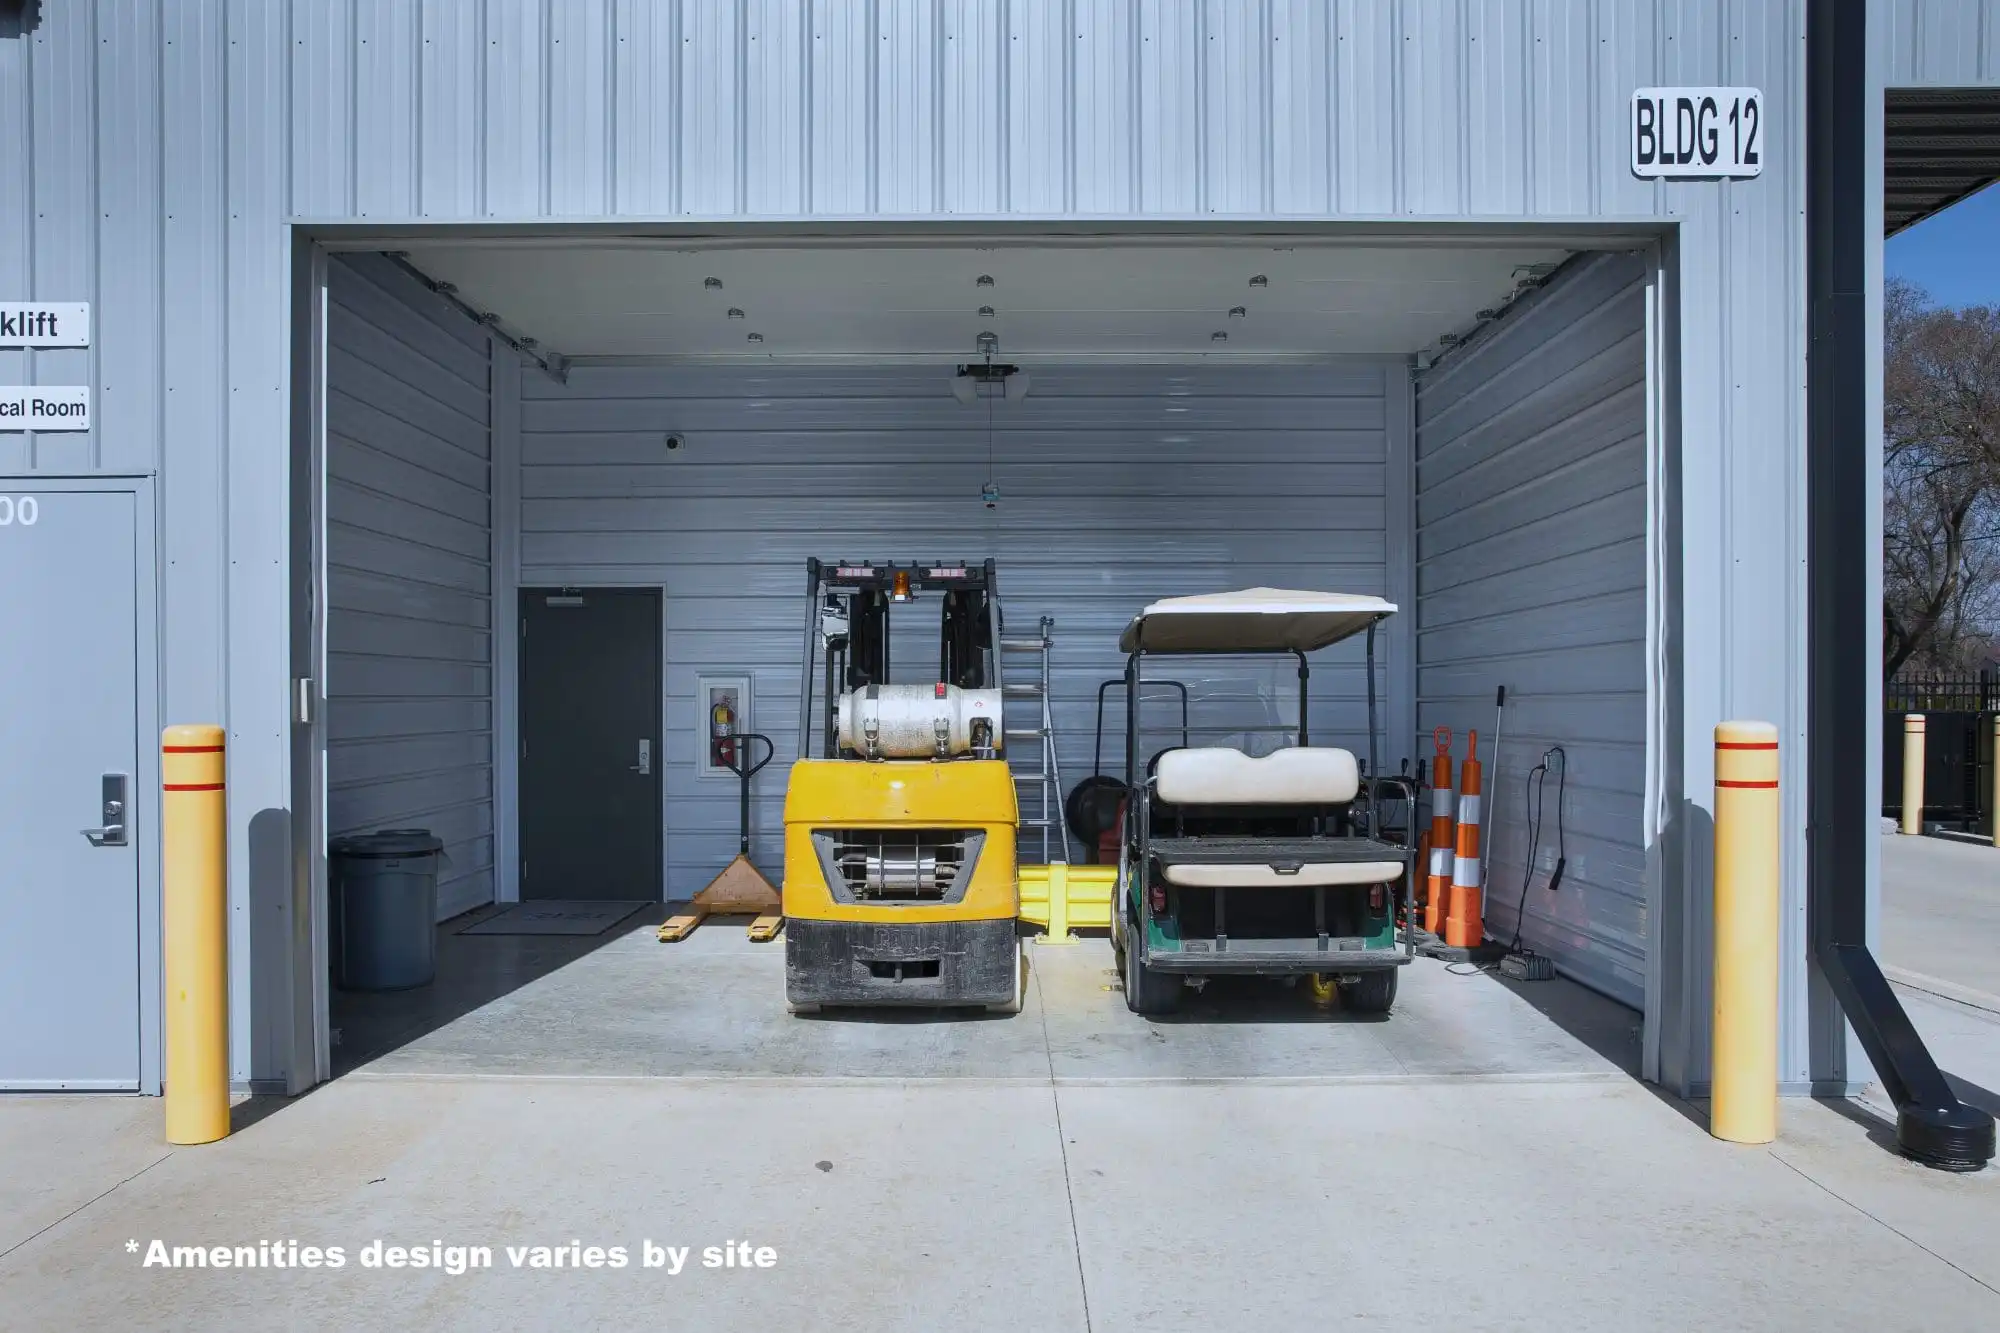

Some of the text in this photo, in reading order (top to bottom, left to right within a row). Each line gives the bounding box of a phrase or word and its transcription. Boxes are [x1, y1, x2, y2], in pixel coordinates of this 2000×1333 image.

[1637, 97, 1759, 165] BLDG 12
[0, 311, 58, 337] klift
[32, 399, 86, 417] Room
